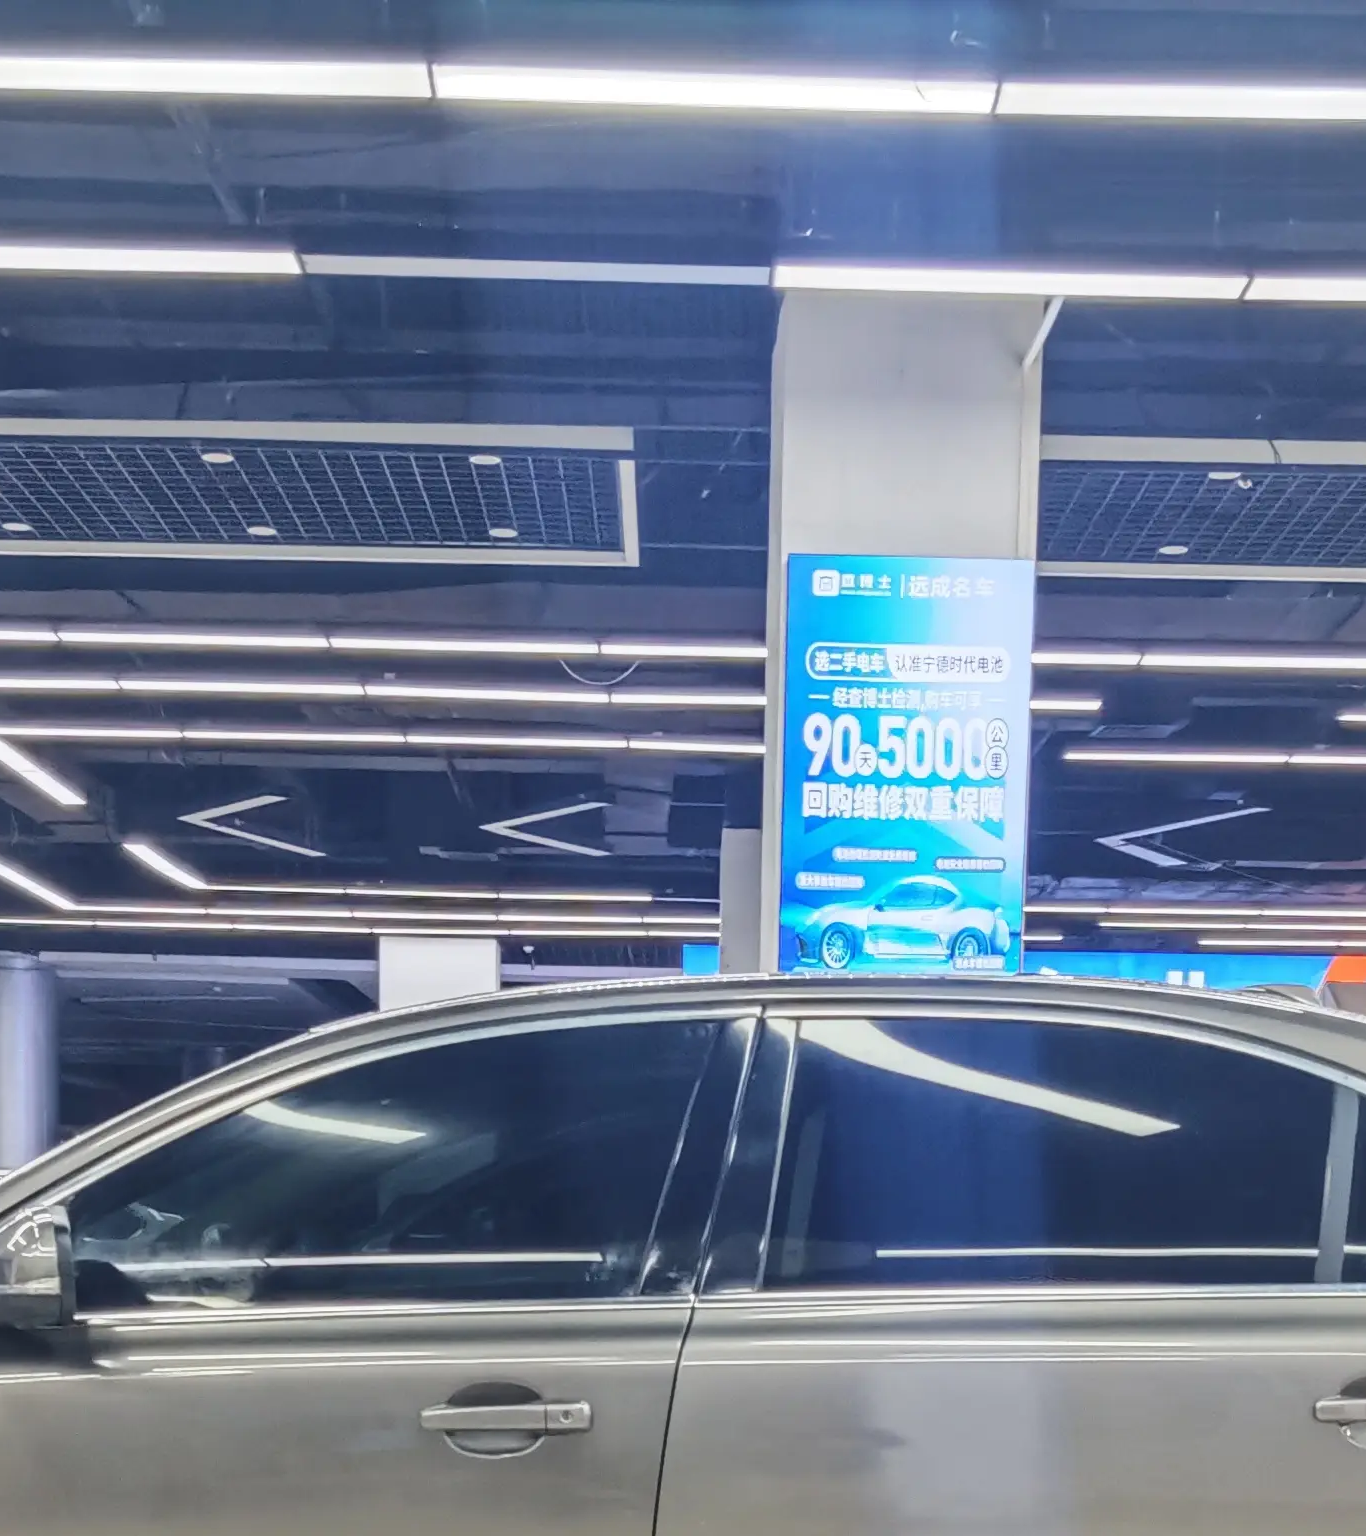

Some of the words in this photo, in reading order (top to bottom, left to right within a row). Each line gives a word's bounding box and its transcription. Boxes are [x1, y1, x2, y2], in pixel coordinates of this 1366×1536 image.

[895, 654, 1004, 674] 认准宁德时代电池
[802, 782, 1005, 822] 回购维修双重保障
